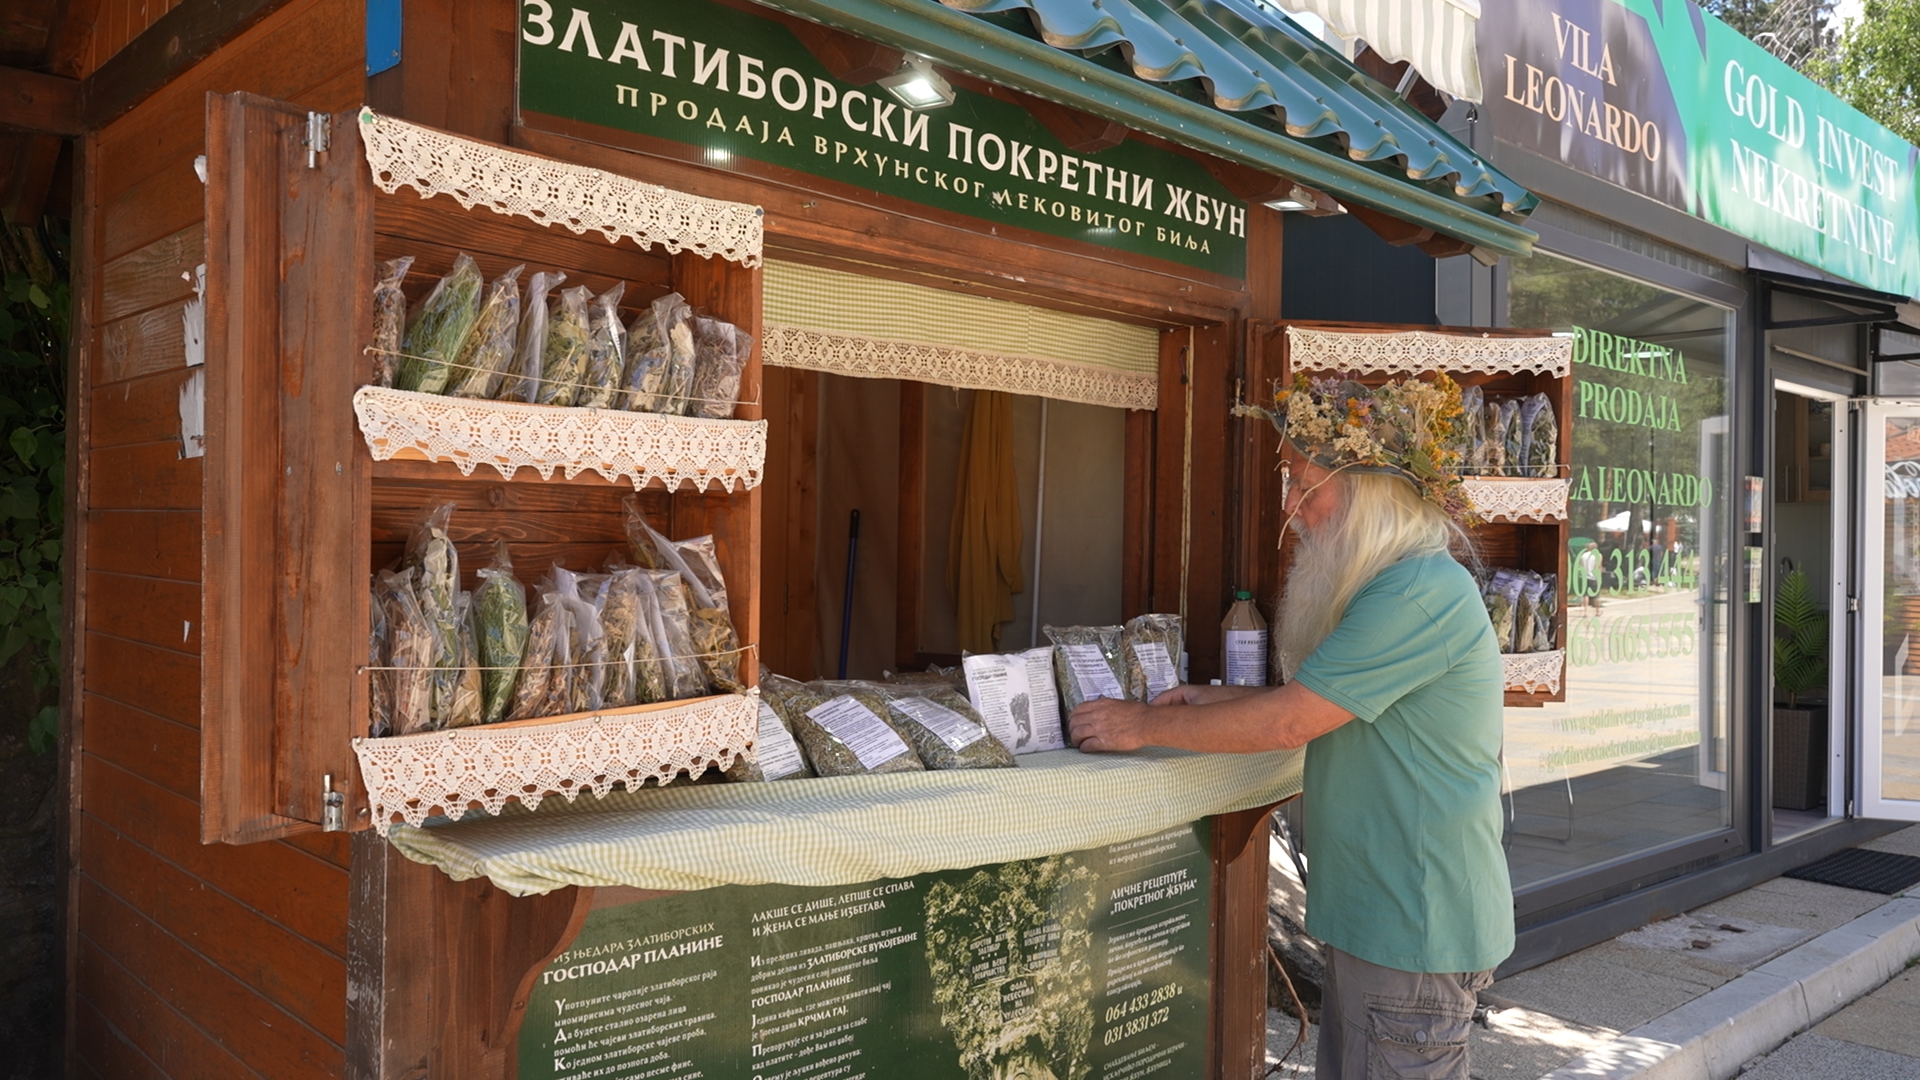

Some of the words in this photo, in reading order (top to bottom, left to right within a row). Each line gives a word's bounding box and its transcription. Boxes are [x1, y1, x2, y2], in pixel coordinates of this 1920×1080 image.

[1550, 12, 1618, 87] VILA
[522, 0, 930, 153] ЗЛАТИБОРСКИ
[947, 121, 1154, 211] ПОКРЕТНИ
[1163, 183, 1246, 239] ЖБУН
[1503, 53, 1662, 162] LEONARDO
[1724, 59, 1806, 150] GOLD
[1817, 114, 1899, 203] INVEST
[615, 84, 796, 147] ПРОДАЈА
[814, 135, 985, 198] ВРХУНСКОГ
[993, 188, 1146, 236] ЛЕКОВИТОГ
[1156, 226, 1211, 255] БИЉА
[1730, 137, 1897, 266] NEKRETNINE
[1571, 325, 1688, 386] DIREKTNA
[1578, 380, 1682, 432] PRODAJA
[1597, 466, 1713, 509] LEONARDO
[1609, 548, 1651, 597] 313
[1658, 548, 1696, 593] 444
[751, 906, 789, 923] ЛАКШЕ
[791, 903, 803, 914] СЕ
[804, 897, 837, 913] ДИШЕ,
[837, 889, 871, 905] ЛЕПШЕ
[872, 886, 884, 897] СЕ
[885, 880, 914, 894] СПАВА
[1110, 882, 1142, 900] ЛИЧНЕ
[1142, 868, 1188, 893] РЕЦЕПТУРЕ
[752, 926, 760, 937] И
[762, 919, 793, 937] ЖЕНА
[795, 916, 807, 928] СЕ
[808, 908, 839, 925] МАЊЕ
[840, 900, 886, 919] ИЗБЕГАВА
[543, 954, 642, 985] ГОСПОДАР
[644, 935, 723, 964] ПЛАНИНЕ
[573, 941, 624, 960] ЊЕДАРА
[627, 922, 715, 951] ЗЛАТИБОРСКИХ
[806, 945, 868, 970] ЗЛАТИБОРСКЕ
[868, 932, 918, 952] ВУКОЈЕБИНЕ
[554, 994, 611, 1016] Употпуните
[751, 987, 804, 1008] ГОСПОДАР
[806, 974, 854, 994] ПЛАНИНЕ.
[1105, 1000, 1128, 1023] 064
[1128, 993, 1149, 1014] 433
[1150, 982, 1176, 1006] 2838
[554, 1028, 573, 1045] Да
[798, 1009, 831, 1027] КРЧМА
[1104, 1024, 1124, 1046] 031
[1124, 1013, 1150, 1038] 3831
[1150, 1006, 1170, 1027] 372
